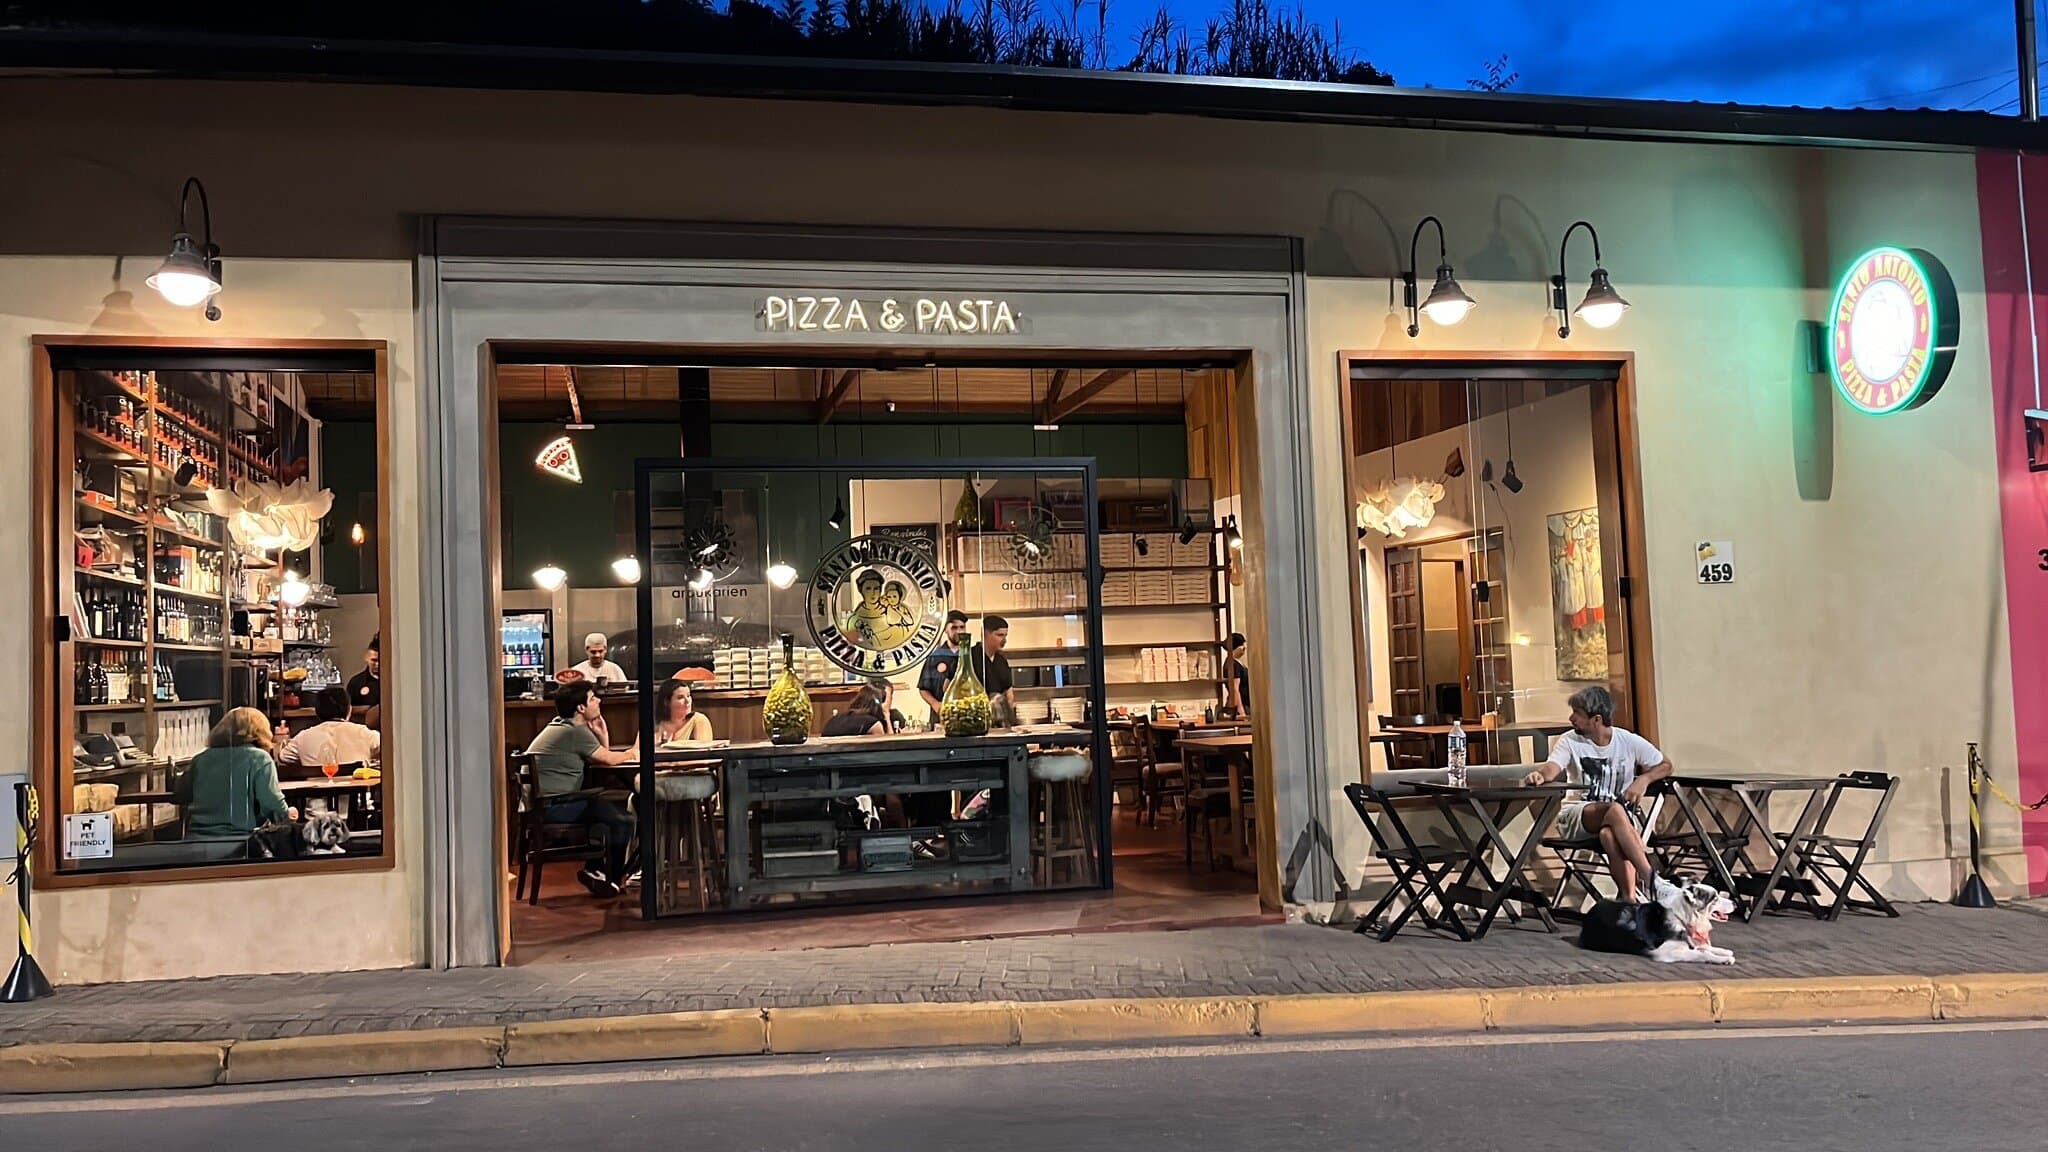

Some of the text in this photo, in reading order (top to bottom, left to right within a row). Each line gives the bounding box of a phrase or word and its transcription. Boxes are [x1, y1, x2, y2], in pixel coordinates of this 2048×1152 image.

[1840, 255, 1927, 322] SANTO ANTONIO
[766, 296, 1017, 331] PIZZA & PASTA
[1841, 348, 1926, 406] PIZZA & PASTA
[817, 542, 936, 593] SANTO ANTONIO
[1700, 563, 1732, 581] 459
[672, 586, 748, 598] araukarien
[820, 624, 937, 669] PIZZA & PASTA
